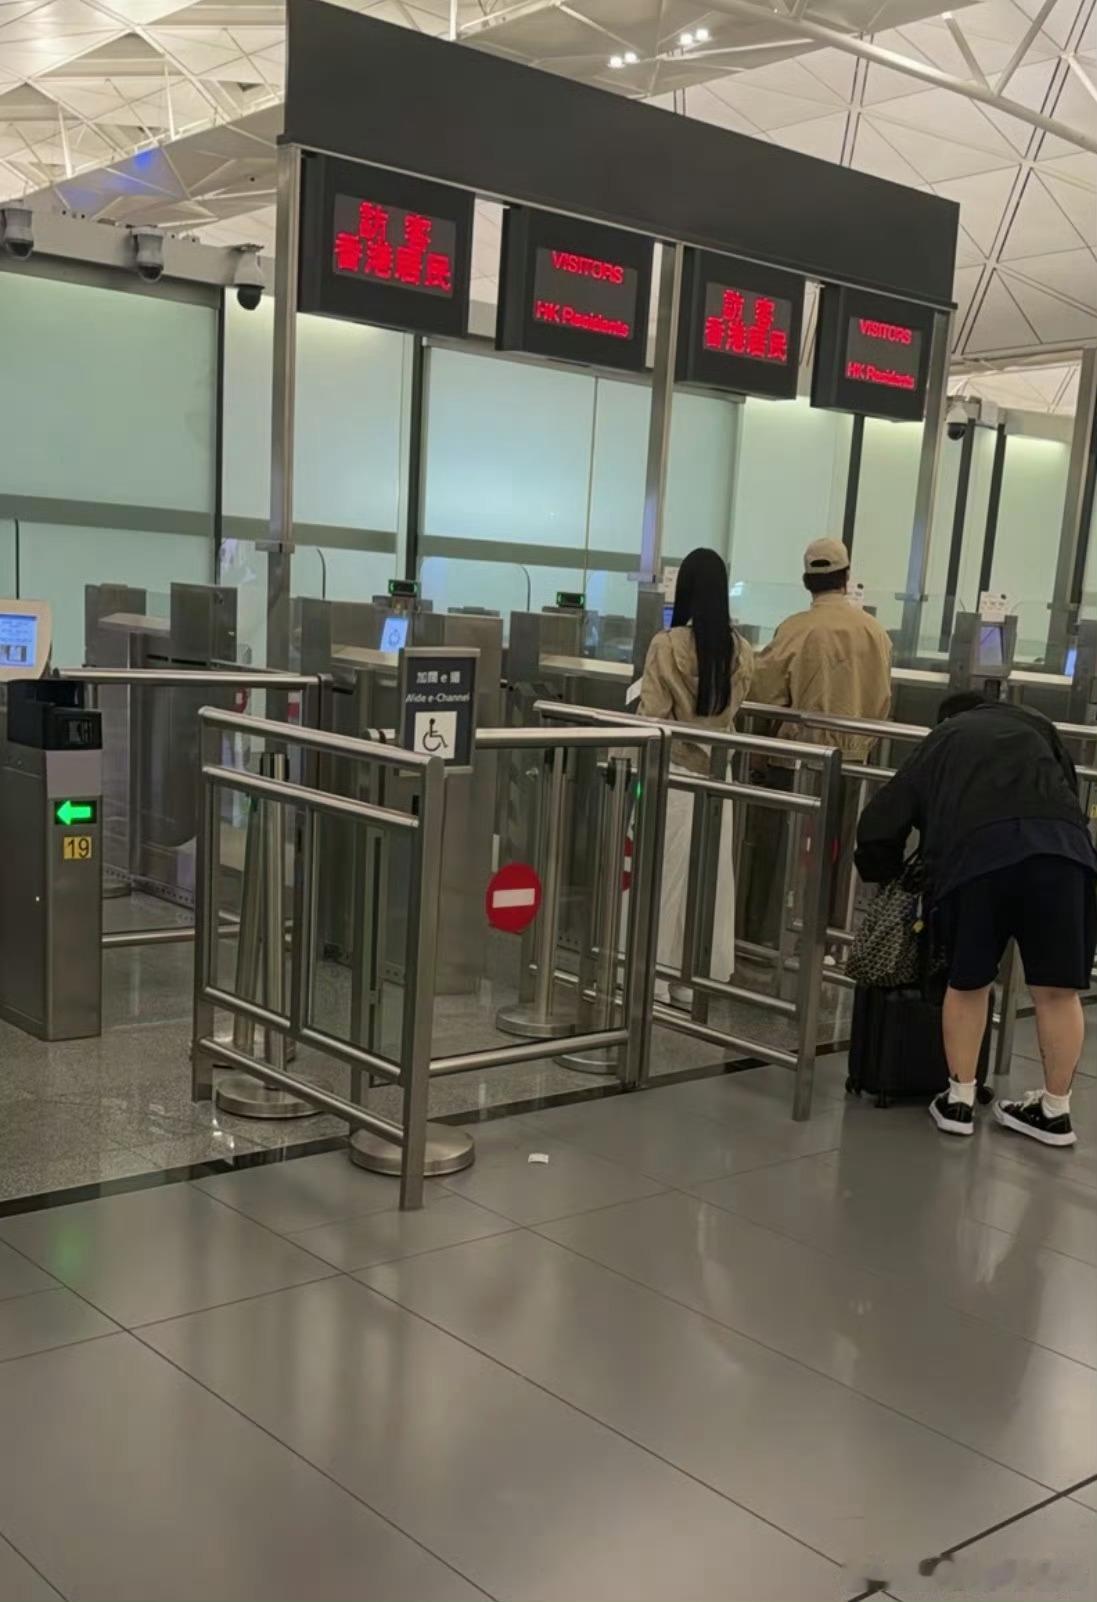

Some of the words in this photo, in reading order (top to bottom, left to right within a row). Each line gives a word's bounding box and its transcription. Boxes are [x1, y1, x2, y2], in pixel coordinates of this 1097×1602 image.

[359, 201, 432, 250] 訪客
[334, 232, 451, 291] 香港居民
[551, 250, 624, 284] VISITORS
[535, 300, 560, 323] HK
[562, 306, 630, 338] Residents
[859, 319, 912, 344] VISITORS
[705, 316, 787, 362] 香港居民
[847, 362, 866, 379] HK
[866, 365, 915, 390] Residents
[427, 692, 470, 703] e-Channel
[67, 837, 90, 858] 19
